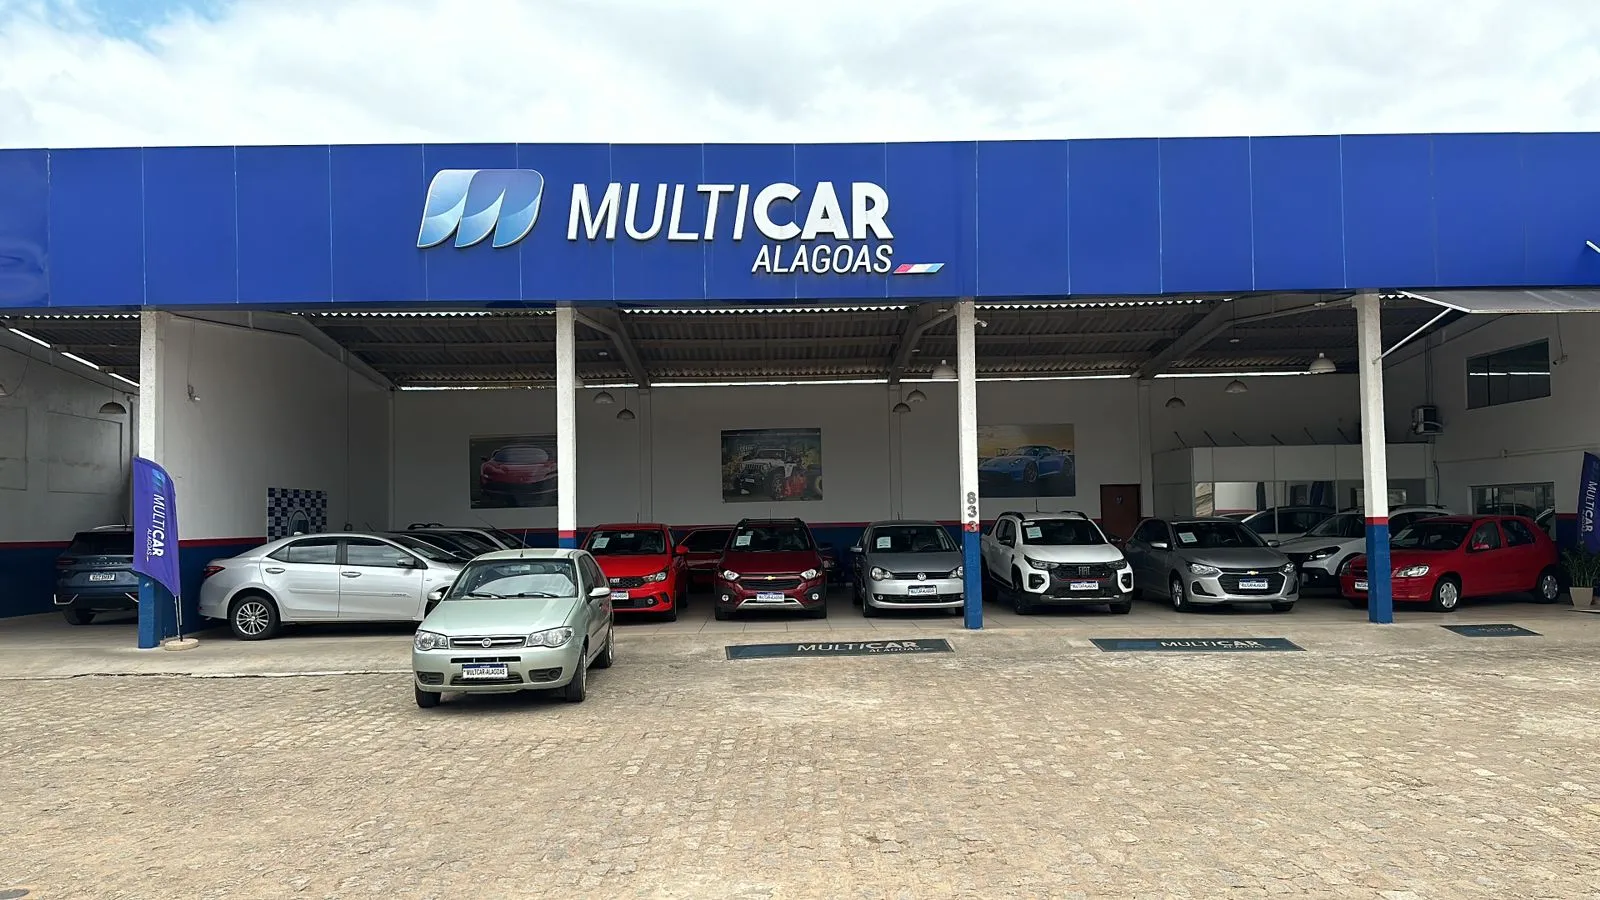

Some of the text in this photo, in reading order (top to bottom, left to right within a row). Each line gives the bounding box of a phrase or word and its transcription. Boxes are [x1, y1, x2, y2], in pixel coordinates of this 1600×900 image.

[567, 181, 894, 241] MULTICAR
[751, 244, 893, 274] ALAGOAS
[152, 494, 165, 557] MULTICAR
[1584, 480, 1598, 532] MULTICAR
[797, 641, 918, 651] MULTICAR
